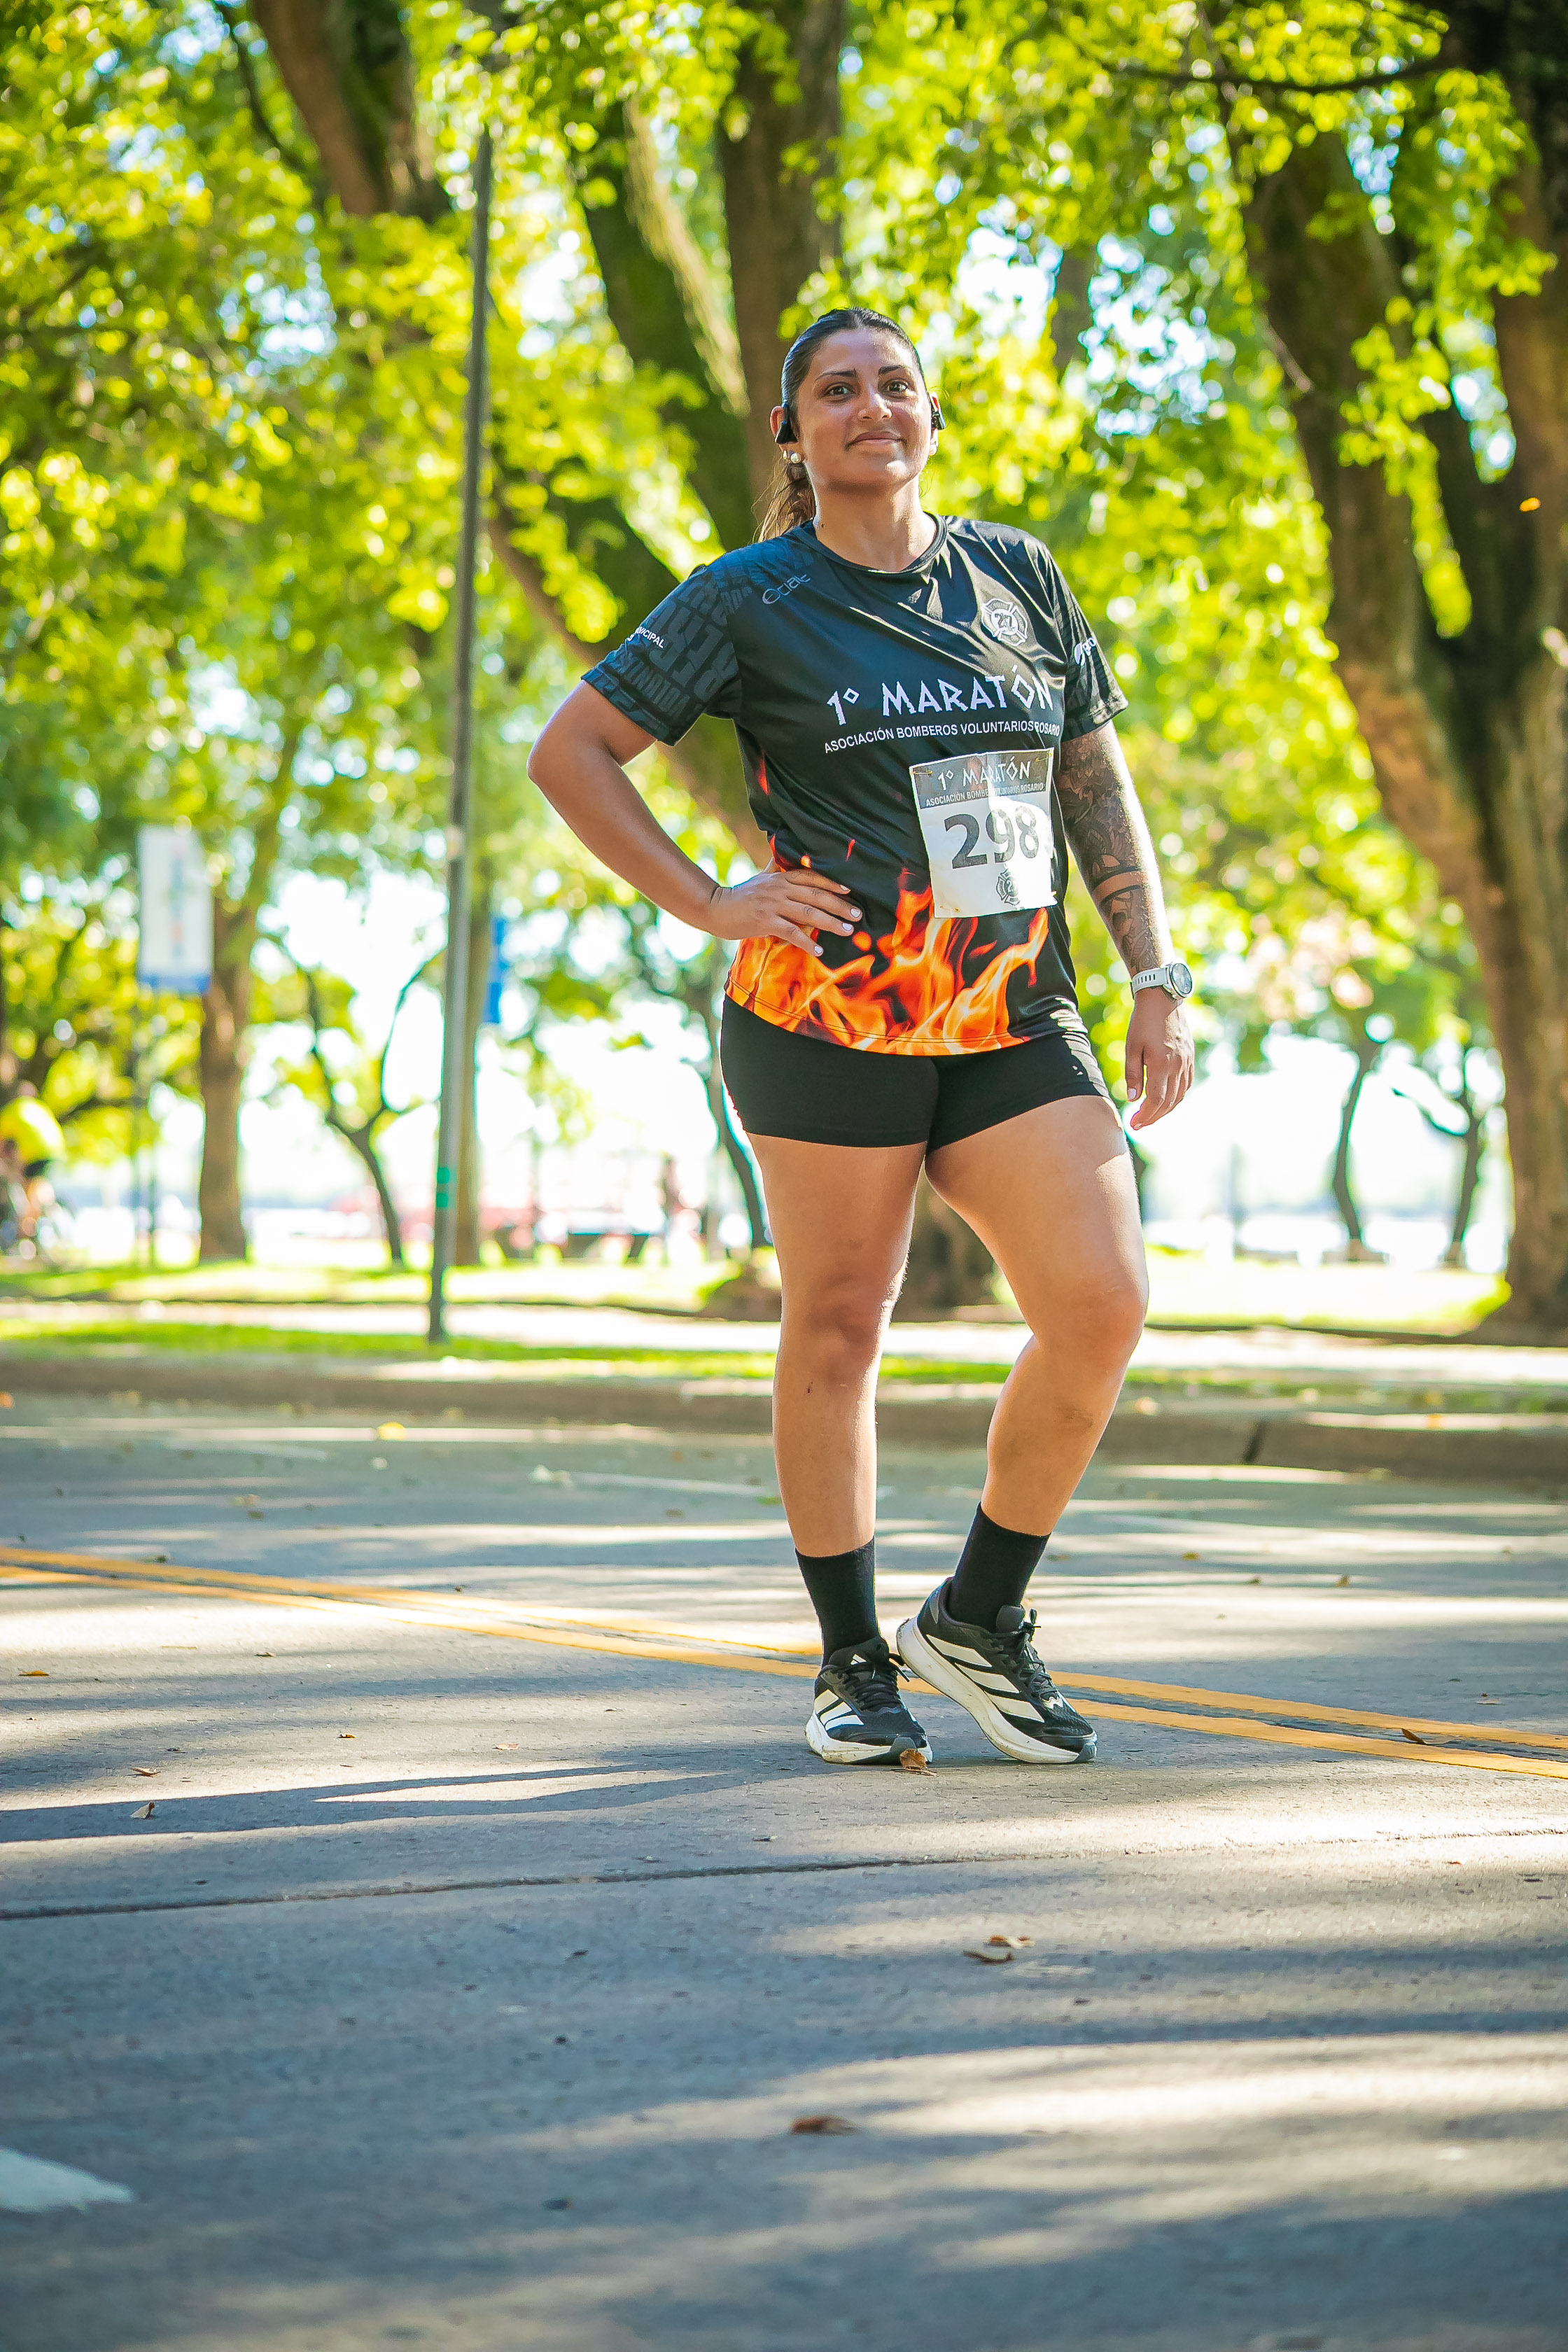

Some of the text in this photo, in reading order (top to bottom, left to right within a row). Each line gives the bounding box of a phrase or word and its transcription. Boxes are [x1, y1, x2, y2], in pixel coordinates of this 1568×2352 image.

[881, 665, 1054, 717] MARATÓN
[825, 720, 1060, 754] ASOCIACIÓN BOMBEROS VOLUNTARIOS ROSARIO
[962, 755, 1031, 787] MARATÓN
[925, 791, 966, 807] ASOCIACIÓN
[1021, 782, 1044, 793] ROSARIO
[944, 806, 1040, 869] 298
